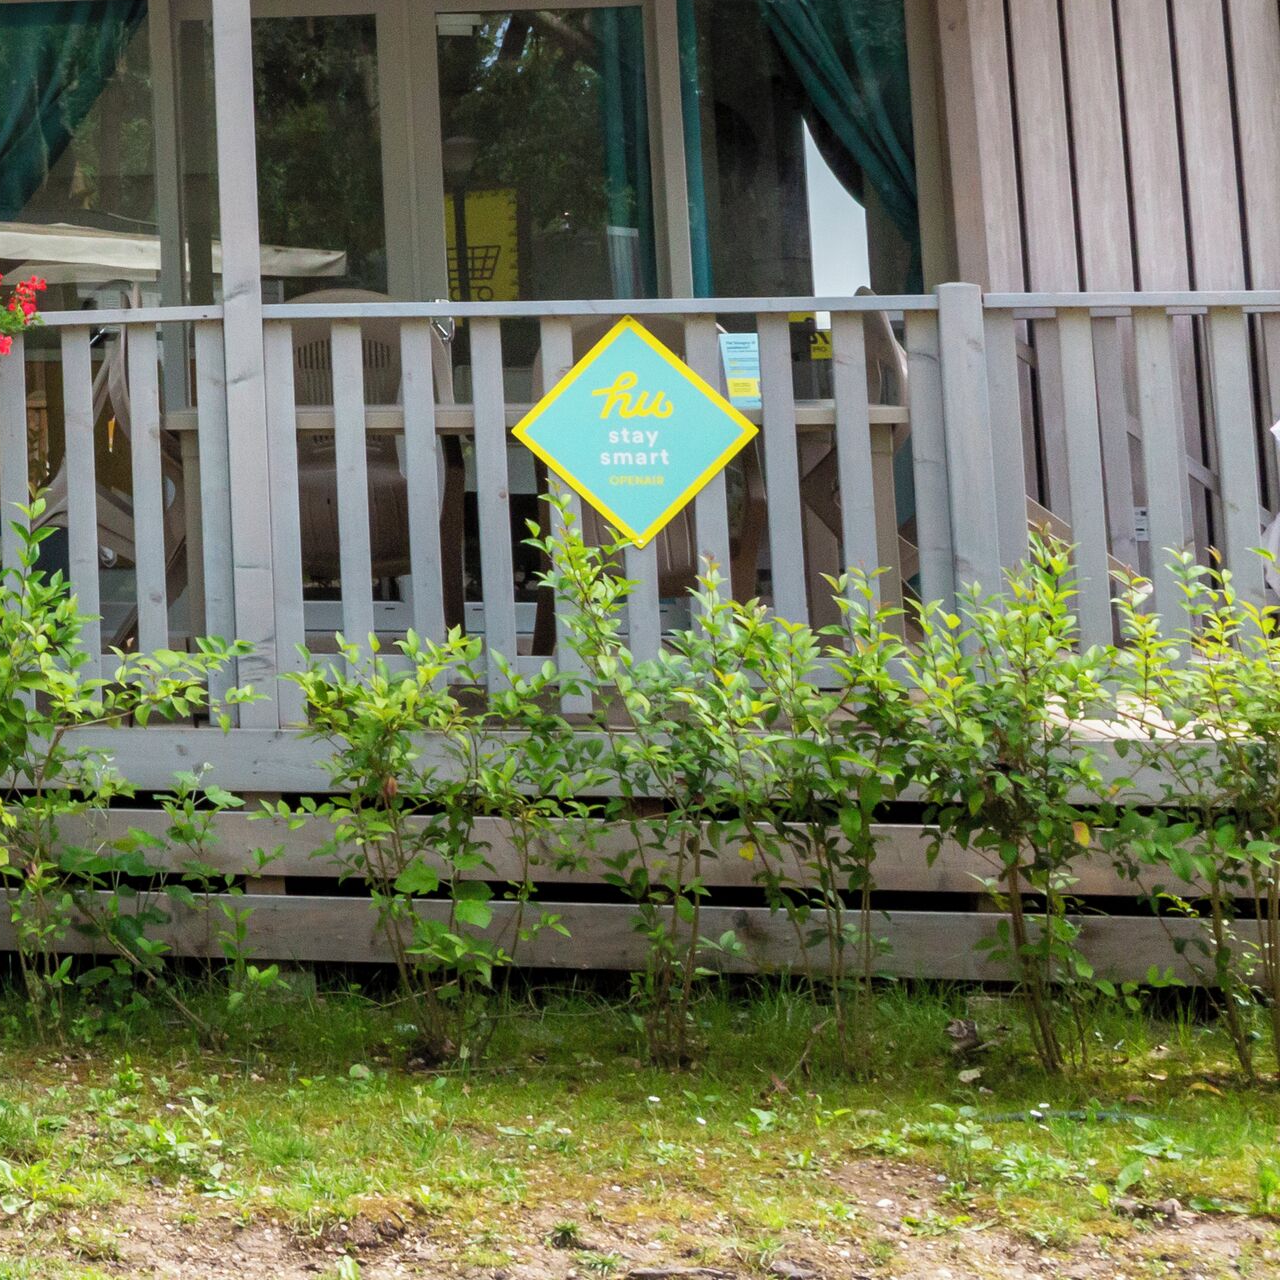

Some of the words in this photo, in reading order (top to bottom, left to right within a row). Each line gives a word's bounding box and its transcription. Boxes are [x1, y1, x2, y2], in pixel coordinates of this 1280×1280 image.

[592, 371, 673, 419] hu
[608, 428, 658, 448] stay
[600, 449, 669, 465] smart
